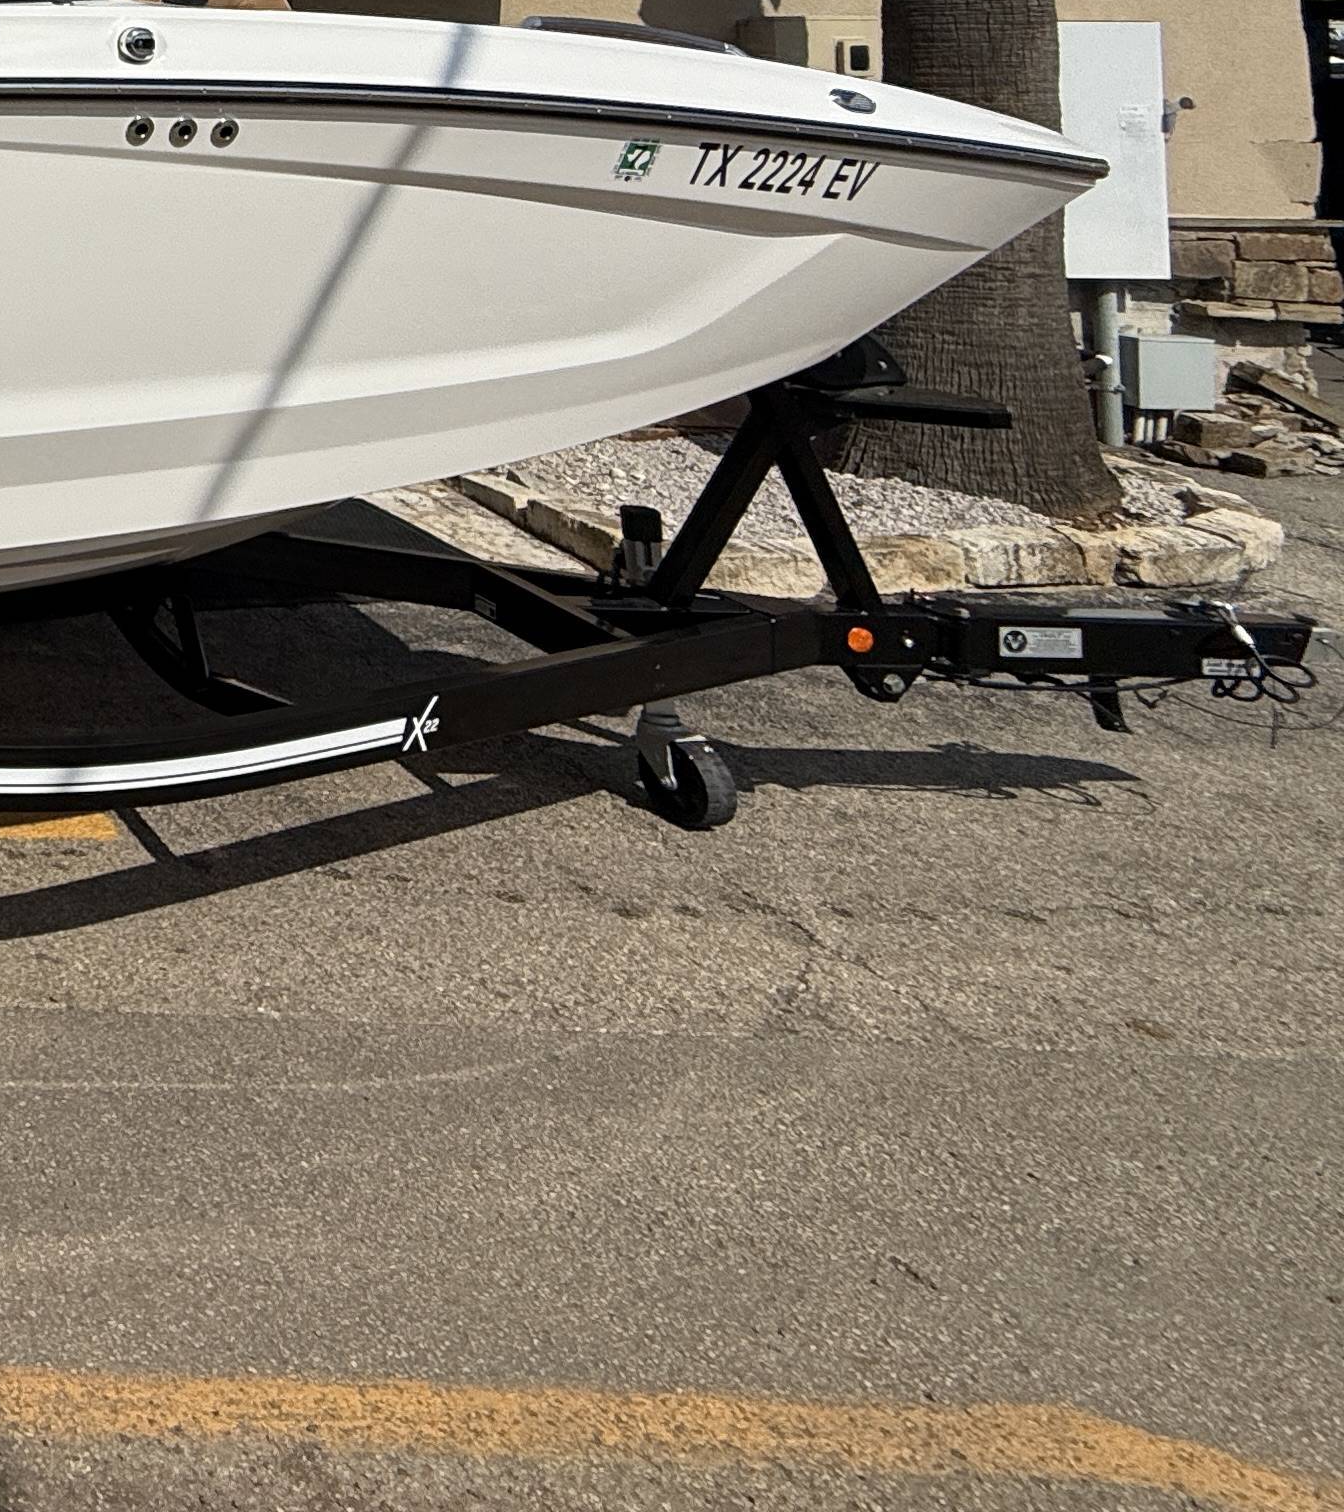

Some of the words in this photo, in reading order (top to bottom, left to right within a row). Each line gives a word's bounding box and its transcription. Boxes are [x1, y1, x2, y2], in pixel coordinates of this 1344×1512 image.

[689, 142, 745, 187] TX
[737, 147, 828, 196] 2224
[822, 157, 881, 201] EV
